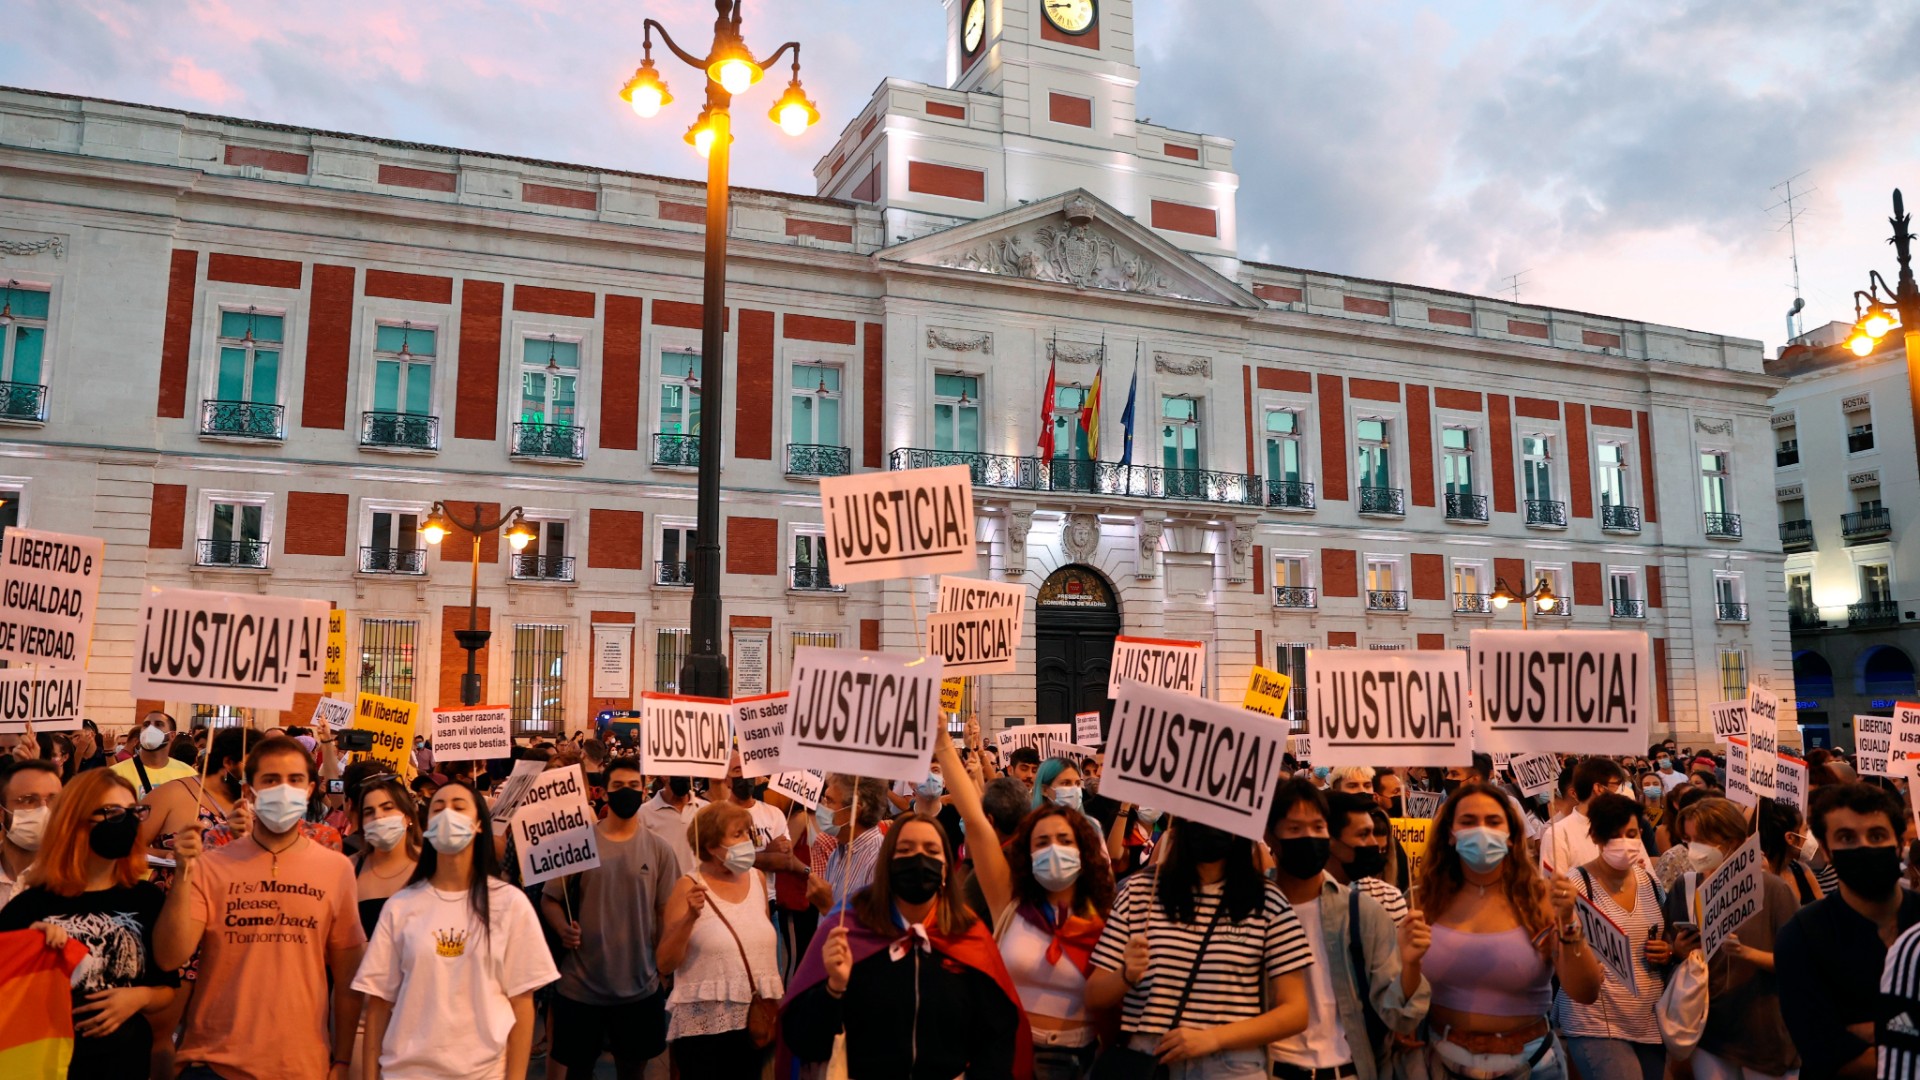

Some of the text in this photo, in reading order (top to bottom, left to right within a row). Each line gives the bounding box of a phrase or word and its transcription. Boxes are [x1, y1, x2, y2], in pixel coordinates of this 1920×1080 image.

[1843, 399, 1868, 409] HOSTAL
[1850, 473, 1876, 484] HOSTAL
[830, 483, 968, 558] ¡JUSTICIA!
[9, 537, 92, 576] LIBERTAD e
[3, 579, 83, 623] IGUALDAD,
[20, 624, 76, 661] VERDAD.
[140, 607, 295, 684] ¡JUSTICIA!
[1259, 676, 1286, 699] libertad
[1478, 650, 1637, 724] ¡JUSTICIA!
[360, 699, 410, 725] Mi libertad
[437, 713, 506, 723] Sin saber razonar,
[739, 702, 789, 721] Sin saber
[792, 667, 933, 750] ¡JUSTICIA!
[1316, 670, 1461, 739] ¡JUSTICIA!
[437, 724, 506, 737] usan vil violencia,
[647, 707, 730, 760] ¡JUSTICIA!
[744, 721, 784, 741] usan vil
[1859, 719, 1893, 735] LIBERTAD
[435, 738, 509, 753] peores que bestias.
[743, 746, 780, 765] peores
[1112, 701, 1277, 810] ¡JUSTICIA!
[1732, 745, 1743, 758] Sin
[1861, 757, 1870, 770] DE
[522, 805, 589, 845] Igualdad,
[530, 838, 596, 875] Laicidad.
[1704, 848, 1755, 906] LIBERTAD e
[226, 898, 280, 914] please,
[1704, 873, 1757, 930] IGUALDAD,
[224, 931, 308, 945] Tomorrow.
[1705, 898, 1755, 955] DE VERDAD.
